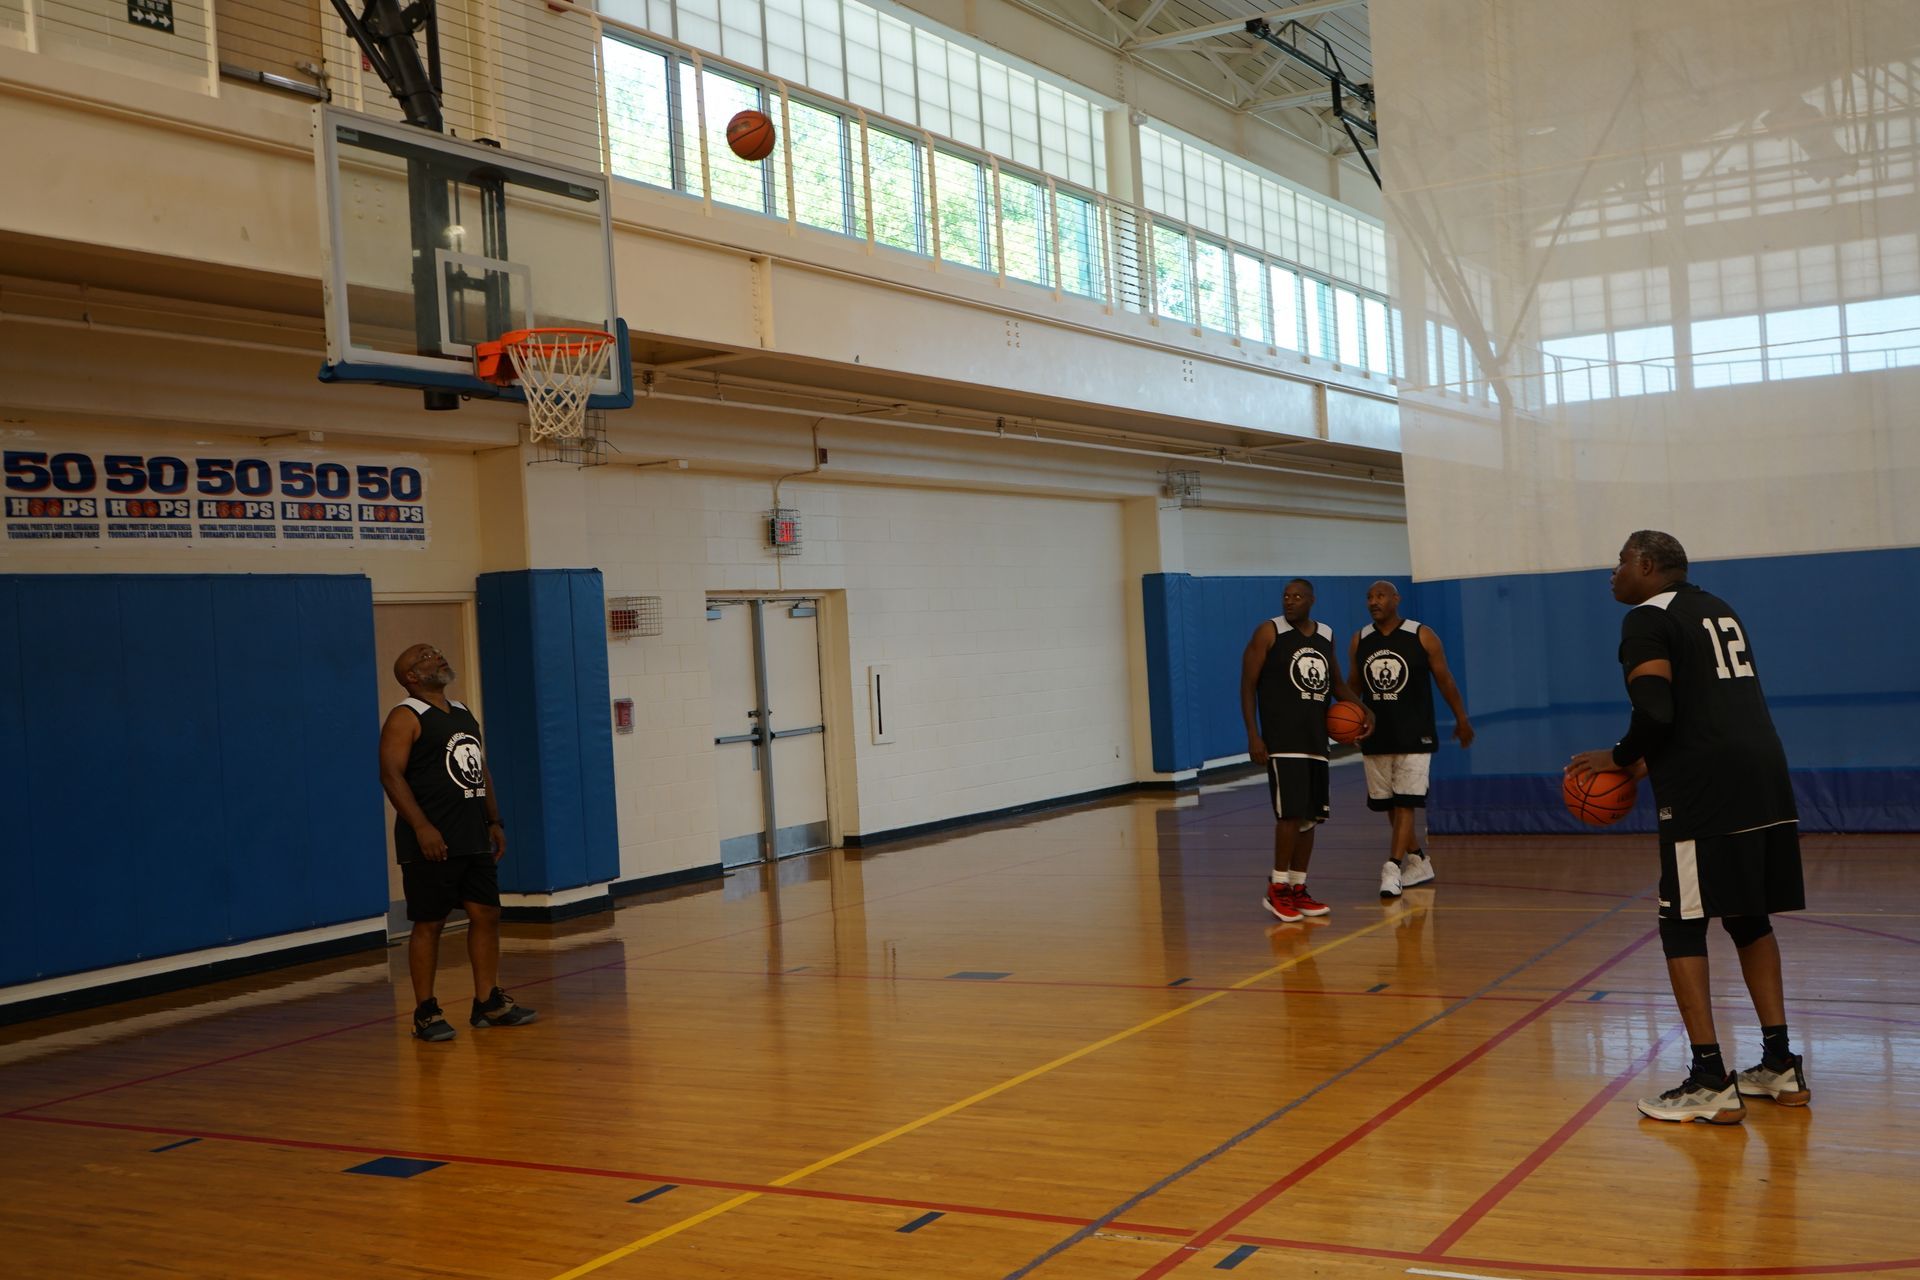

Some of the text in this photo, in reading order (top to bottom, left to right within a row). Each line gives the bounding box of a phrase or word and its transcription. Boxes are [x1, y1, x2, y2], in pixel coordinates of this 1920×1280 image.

[3, 451, 96, 493] 50
[103, 455, 189, 495] 50
[196, 458, 273, 497] 50
[279, 461, 351, 499] 50
[356, 465, 422, 502] 50
[1702, 617, 1755, 679] 12
